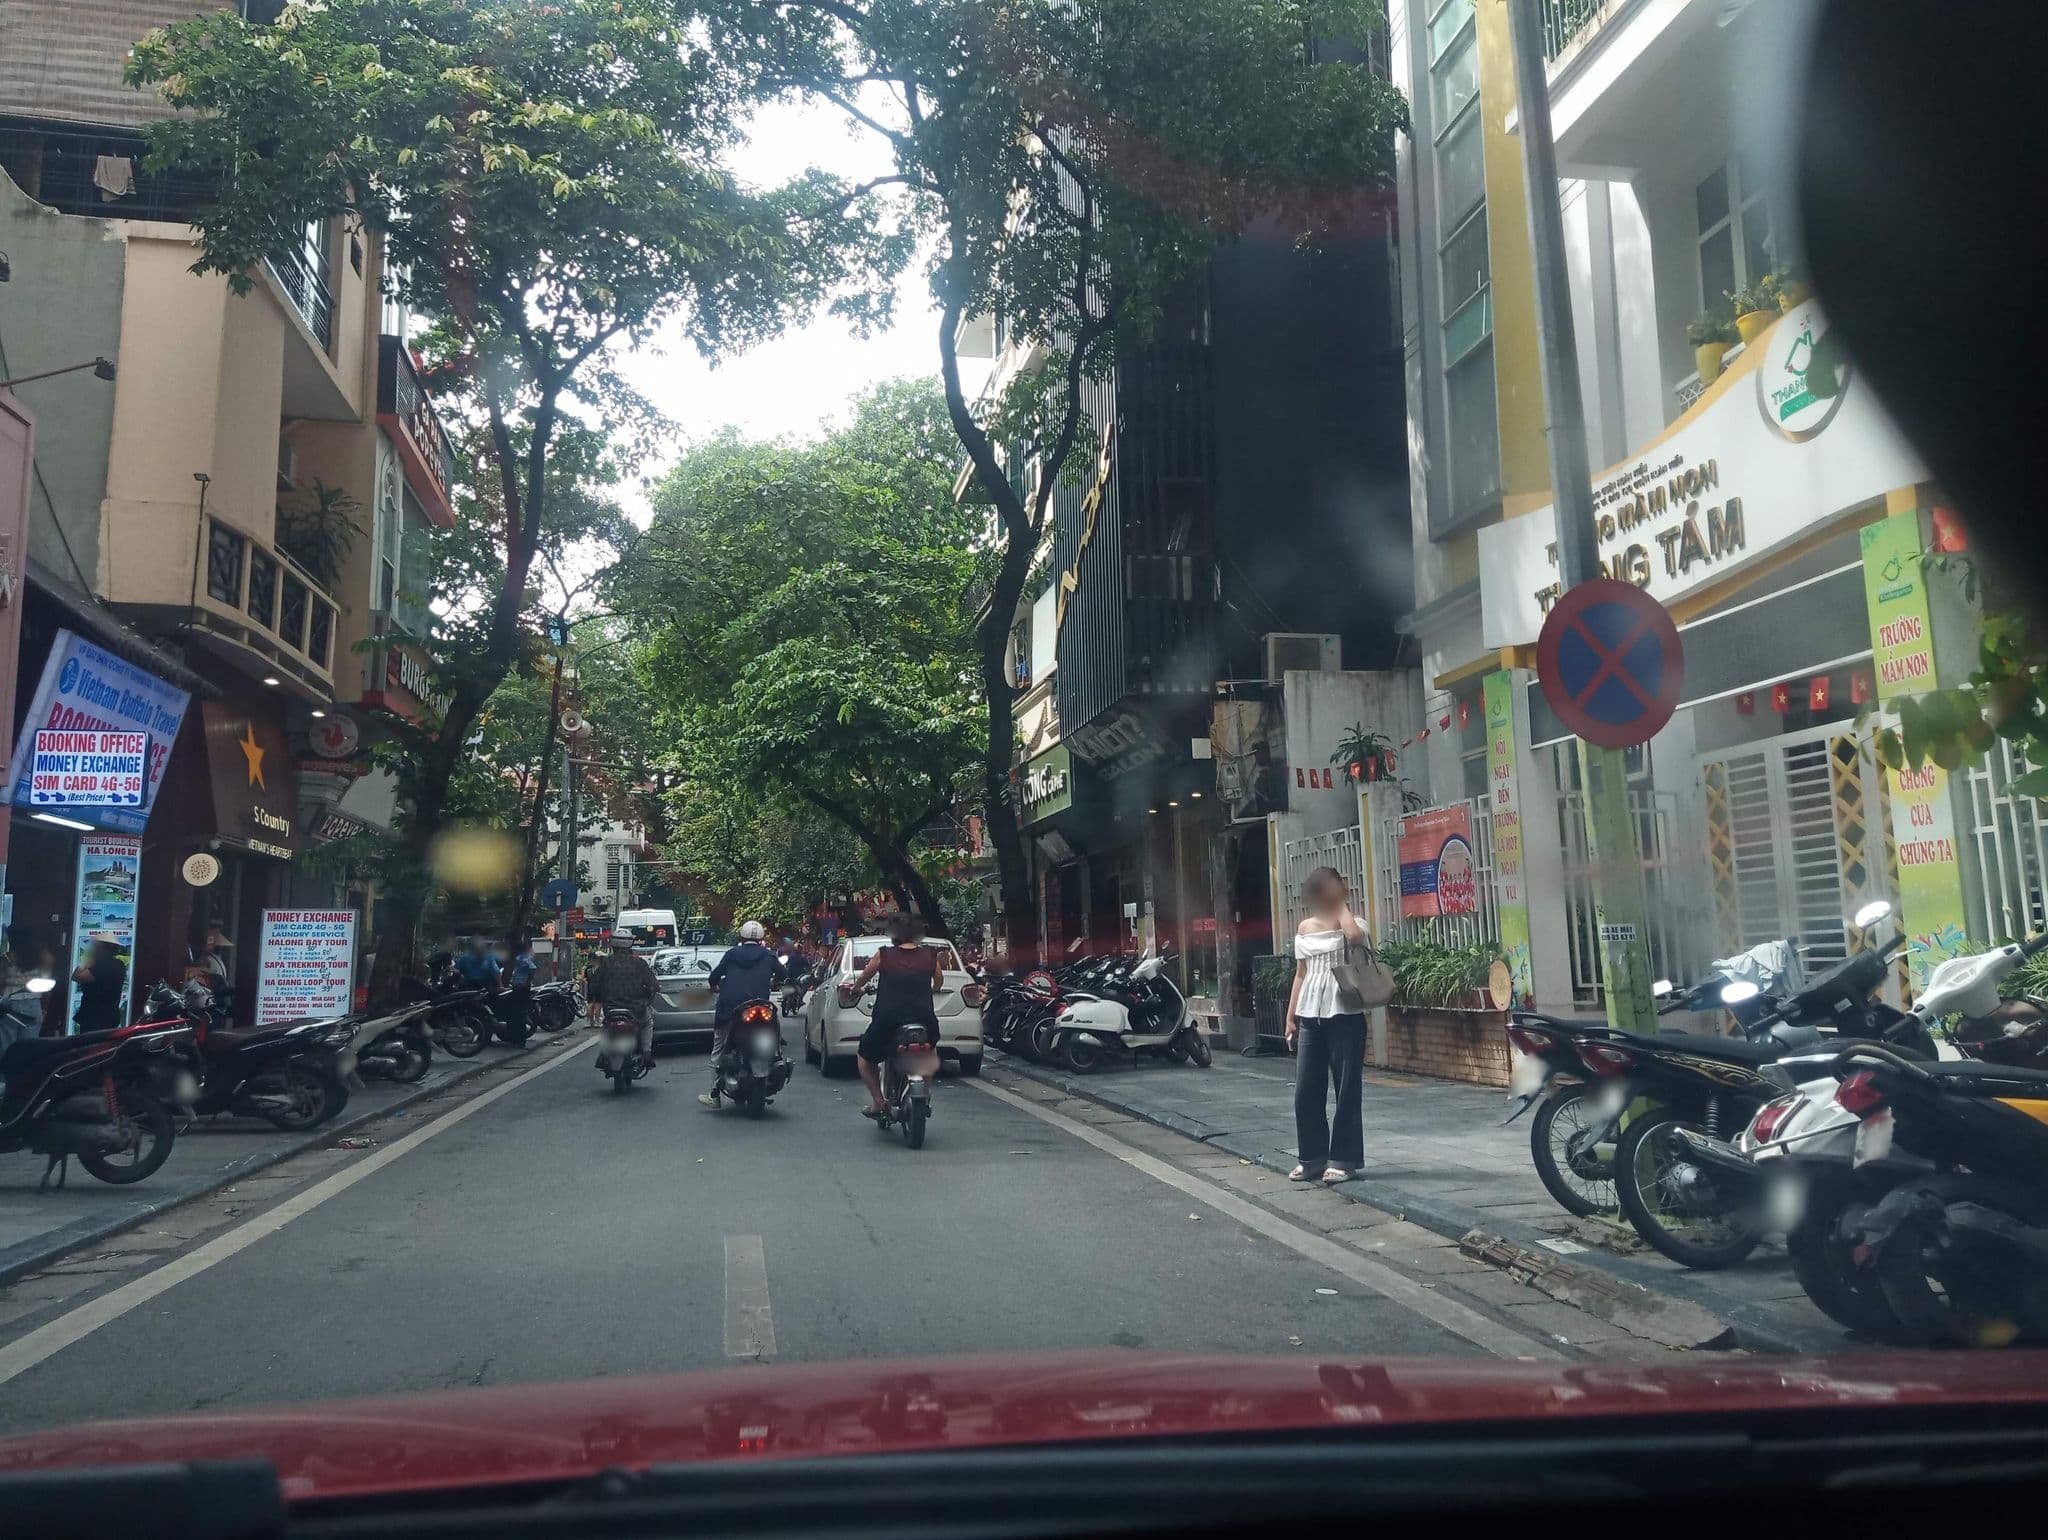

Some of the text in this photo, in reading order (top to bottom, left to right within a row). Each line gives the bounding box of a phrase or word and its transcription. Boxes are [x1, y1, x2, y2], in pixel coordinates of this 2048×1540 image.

[1669, 459, 1719, 507] NON
[1880, 615, 1921, 648] TRƯỜNG
[1881, 651, 1929, 684] MẦM NON
[77, 669, 121, 711] Vietnam
[119, 686, 153, 725] Buffalo
[151, 704, 182, 737] Travel
[38, 733, 143, 753] BOOKING OFFICE
[37, 755, 79, 773] MONEY
[81, 756, 141, 773] EXCHANGE
[34, 775, 141, 791] SIM CARD 4G-5G
[68, 793, 106, 802] (Best Price)
[1910, 796, 1934, 827] CỦA
[254, 805, 290, 837] S Country
[87, 847, 101, 855] HA
[103, 847, 126, 855] LONG
[1900, 837, 1953, 865] CHÚNG TA
[267, 912, 353, 922] MONEY EXCHANGE
